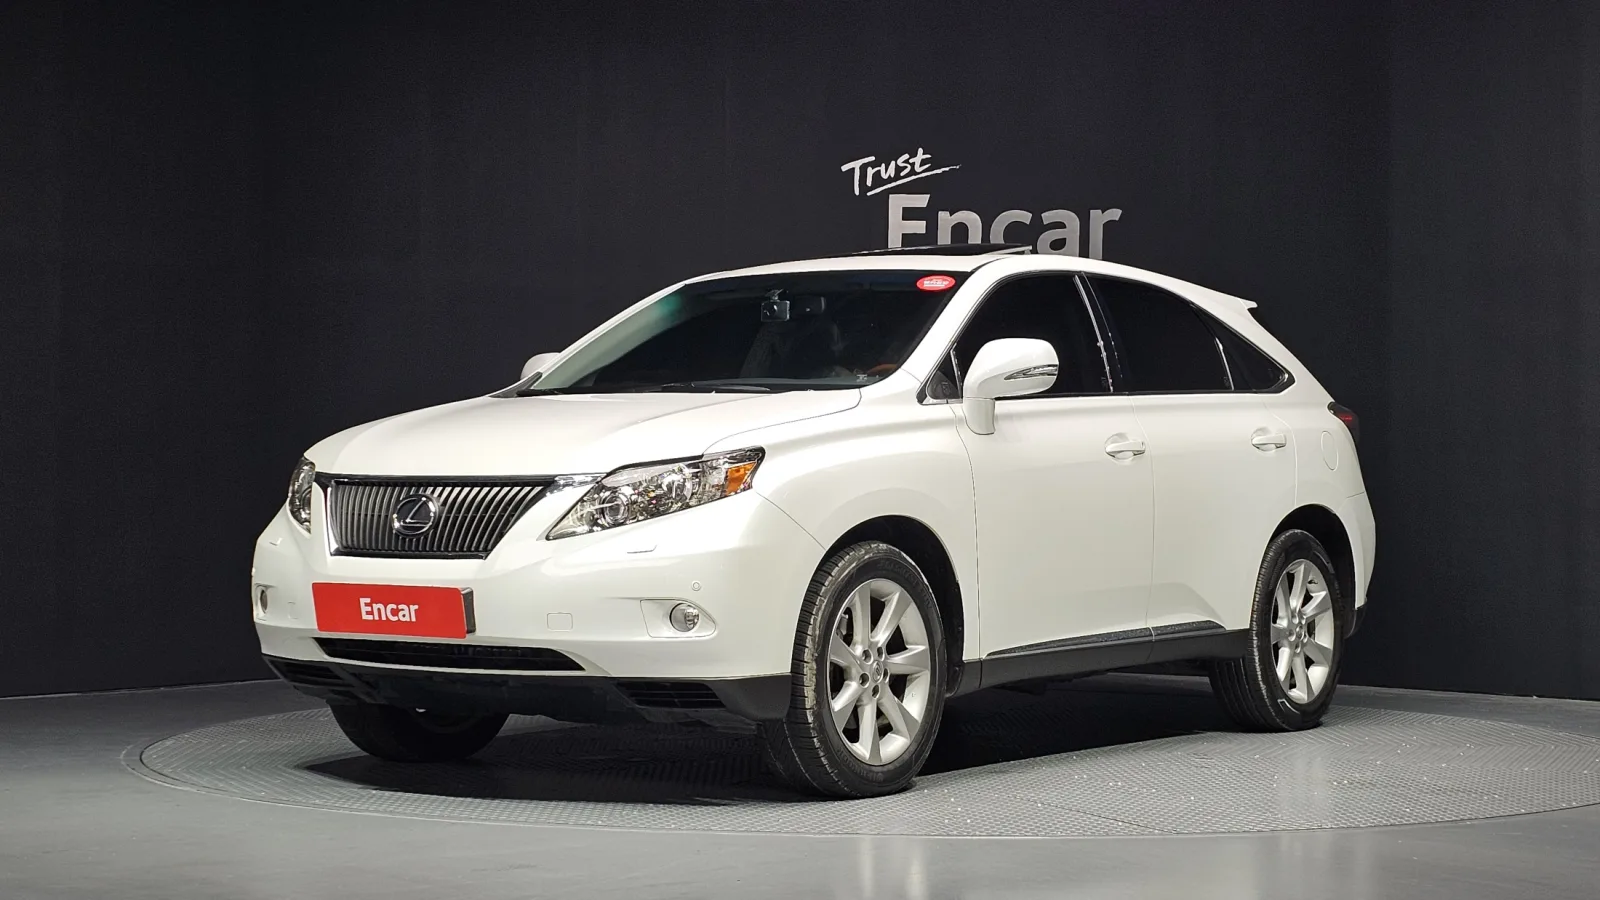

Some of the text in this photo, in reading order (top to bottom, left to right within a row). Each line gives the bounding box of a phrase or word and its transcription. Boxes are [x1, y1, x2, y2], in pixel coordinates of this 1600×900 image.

[841, 147, 932, 196] Trust
[887, 193, 1123, 260] Encar
[359, 597, 419, 622] Encar
